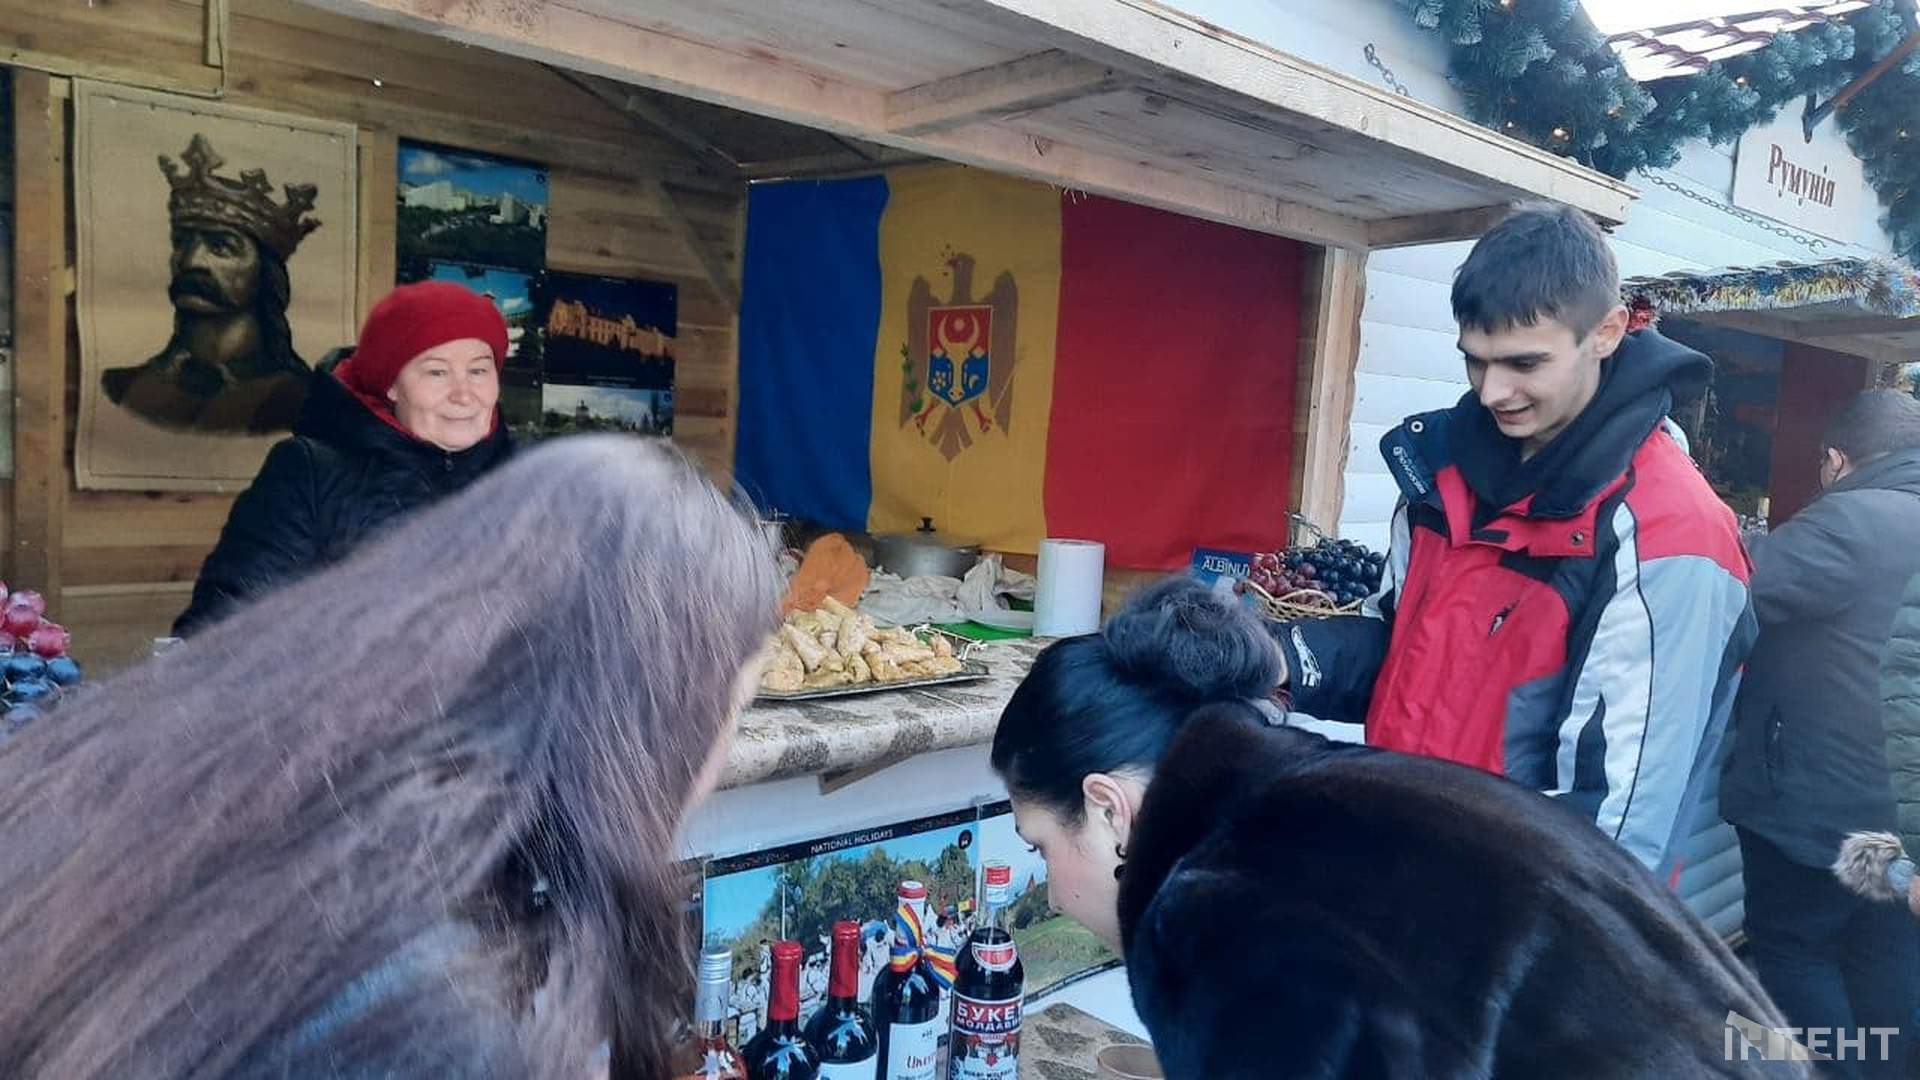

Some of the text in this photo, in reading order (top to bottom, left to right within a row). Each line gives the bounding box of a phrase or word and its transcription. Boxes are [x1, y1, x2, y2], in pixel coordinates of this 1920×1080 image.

[1767, 143, 1836, 208] Румунія
[811, 829, 894, 854] NATIONAL HOLIDAYS
